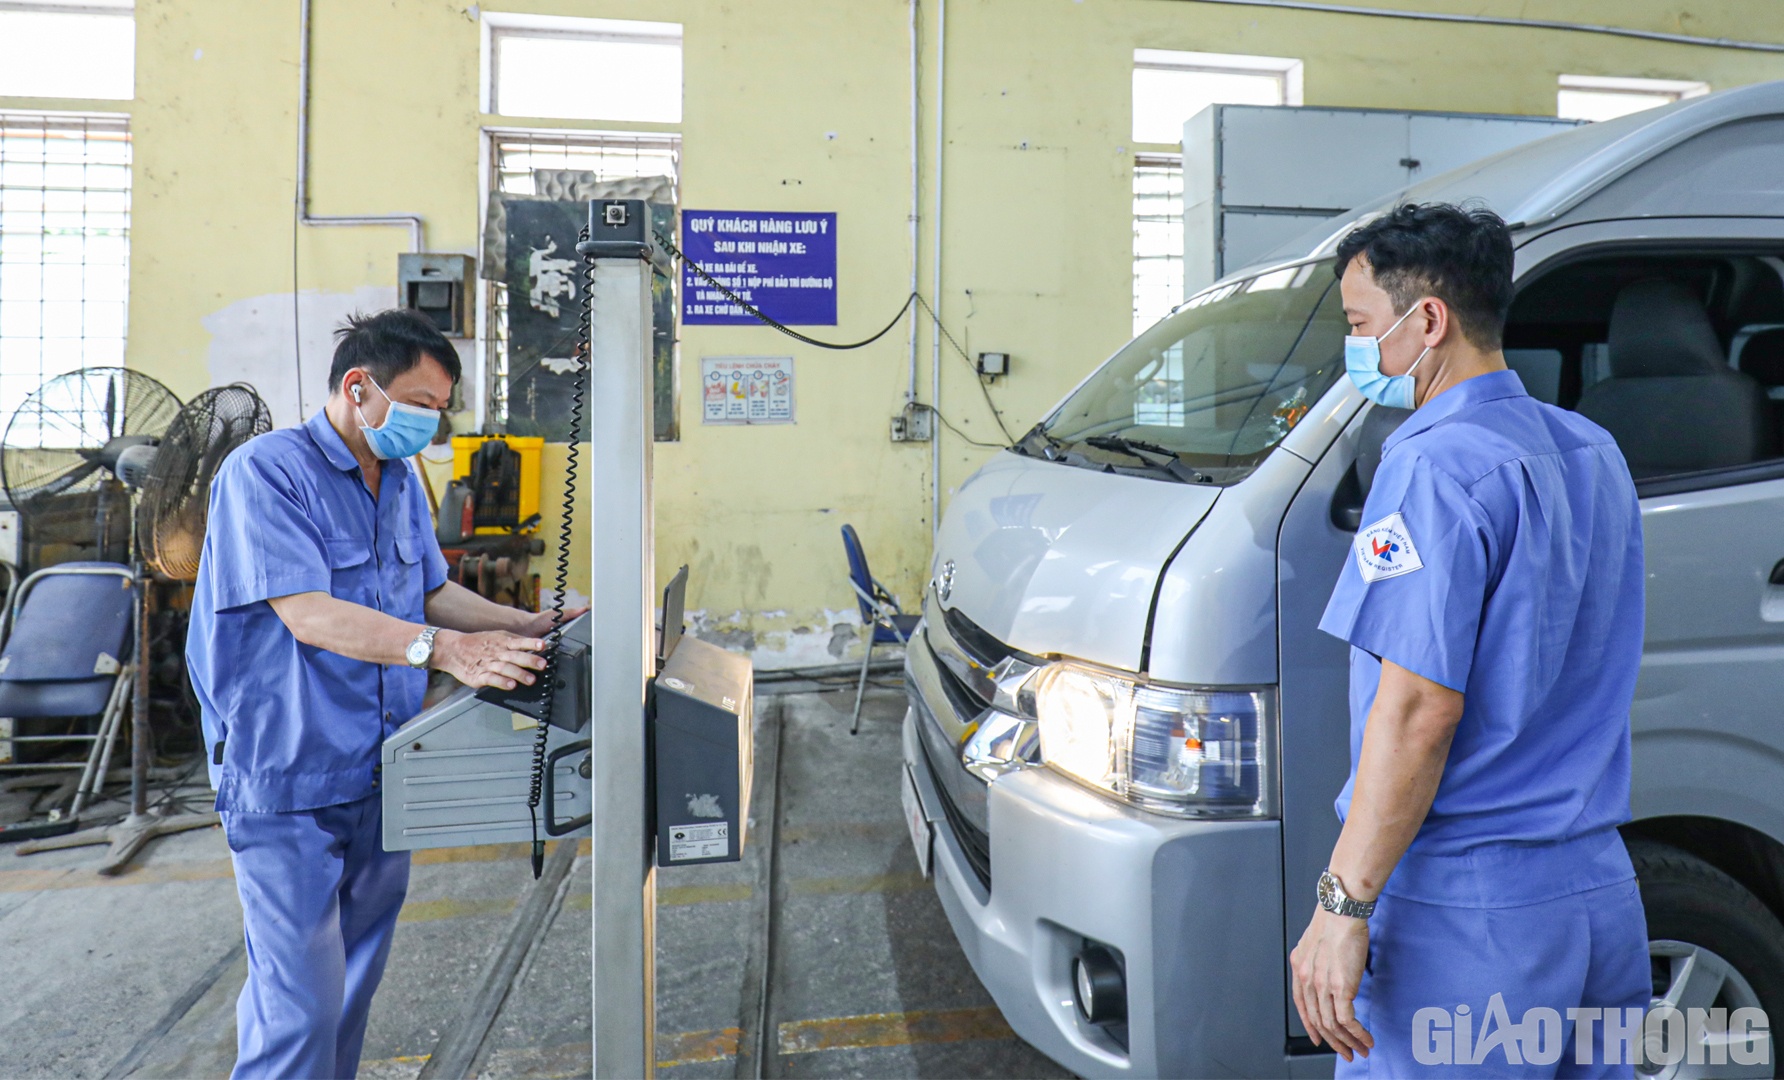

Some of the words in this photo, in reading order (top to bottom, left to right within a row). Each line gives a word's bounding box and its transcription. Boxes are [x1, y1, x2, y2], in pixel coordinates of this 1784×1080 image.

[691, 216, 714, 233] QUÝ
[717, 217, 757, 233] KHÁCH
[760, 217, 792, 233] HÀNG
[795, 219, 817, 234] LƯU
[820, 218, 828, 234] Ý
[714, 241, 736, 253] SAU
[737, 241, 756, 253] KHI
[758, 240, 787, 256] NHẬN
[789, 242, 806, 254] XE:
[705, 263, 713, 273] XE
[686, 277, 693, 287] 2.
[732, 275, 742, 288] SỐ
[743, 277, 746, 287] 1
[696, 289, 705, 301] VÀ
[686, 305, 693, 315] 3.
[705, 305, 713, 315] XE
[1374, 563, 1403, 572] REGISTER
